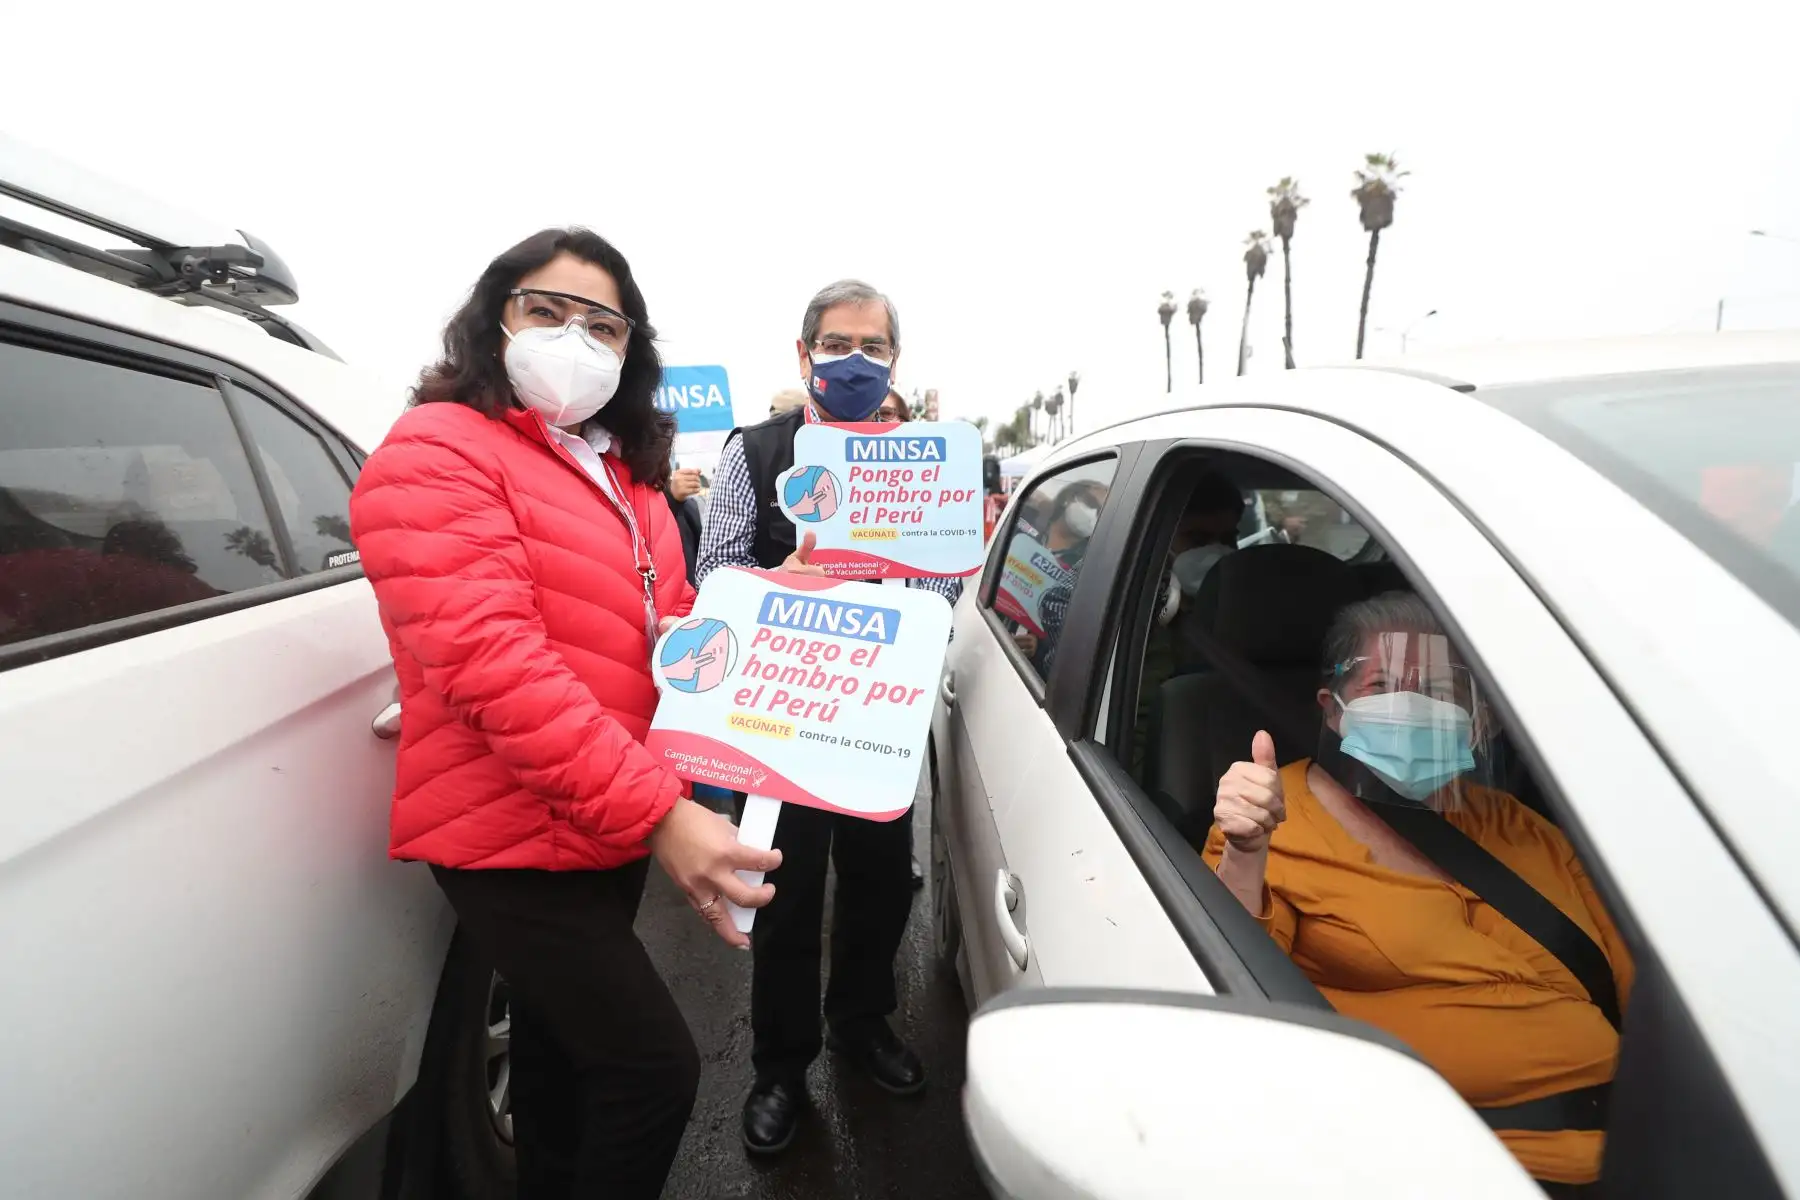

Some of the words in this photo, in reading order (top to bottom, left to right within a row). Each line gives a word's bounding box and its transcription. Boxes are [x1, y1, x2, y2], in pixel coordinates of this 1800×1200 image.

[652, 384, 726, 409] INSA
[852, 439, 941, 461] MINSA
[848, 465, 914, 488] Pongo
[920, 464, 940, 482] el
[848, 485, 932, 503] hombro
[937, 489, 976, 508] por
[849, 506, 869, 524] el
[874, 505, 924, 524] Perú
[852, 527, 897, 538] VACÚNATE
[930, 529, 938, 537] la
[939, 528, 977, 537] COVID-19
[767, 597, 887, 640] MINSA
[750, 627, 842, 665] Pongo
[849, 644, 882, 668] el
[741, 653, 859, 695] hombro
[862, 680, 925, 706] por
[733, 684, 765, 708] el
[766, 688, 840, 723] Perú
[730, 716, 792, 736] VACÚNATE
[799, 729, 838, 745] contra
[840, 736, 851, 747] la
[854, 739, 911, 759] COVID-19
[664, 748, 708, 766] Campaña
[710, 757, 752, 776] Nacional
[675, 762, 688, 773] de
[689, 763, 746, 786] Vacunación
